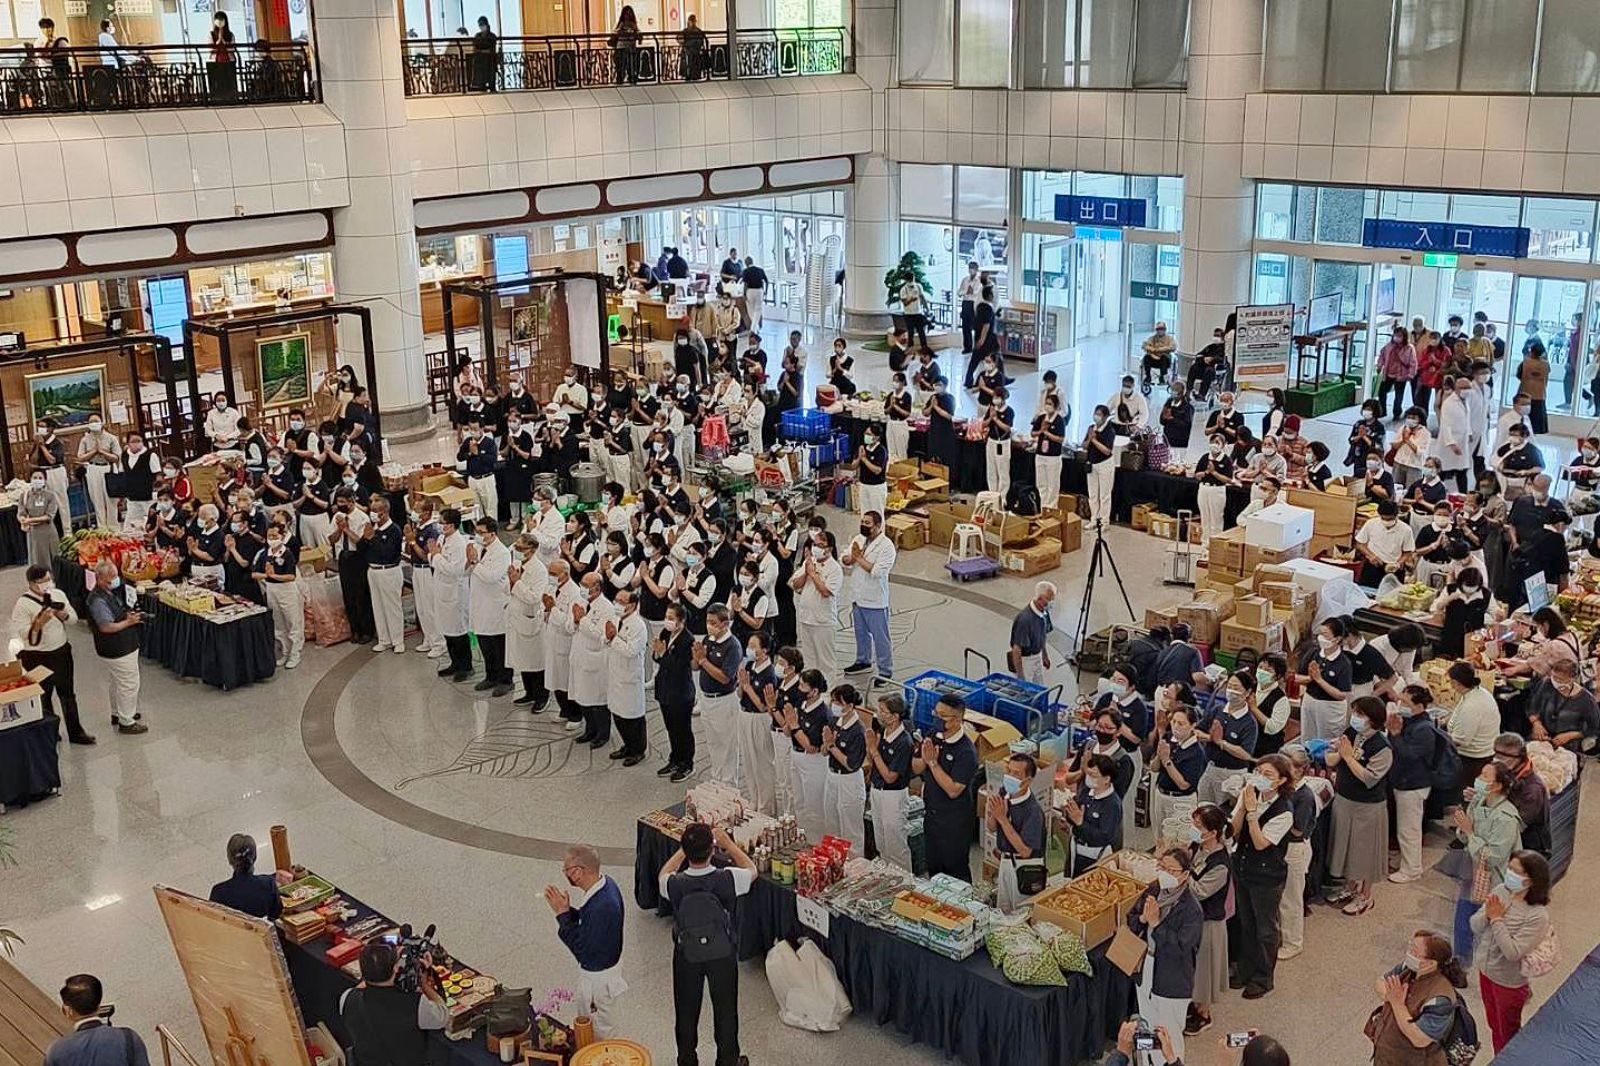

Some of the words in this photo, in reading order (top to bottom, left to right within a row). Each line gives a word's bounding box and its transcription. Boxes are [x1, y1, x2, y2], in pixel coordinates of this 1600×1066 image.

[1079, 200, 1118, 221] 出口
[1415, 227, 1473, 249] 入口
[1261, 262, 1281, 274] 出口
[1144, 285, 1169, 298] 出口
